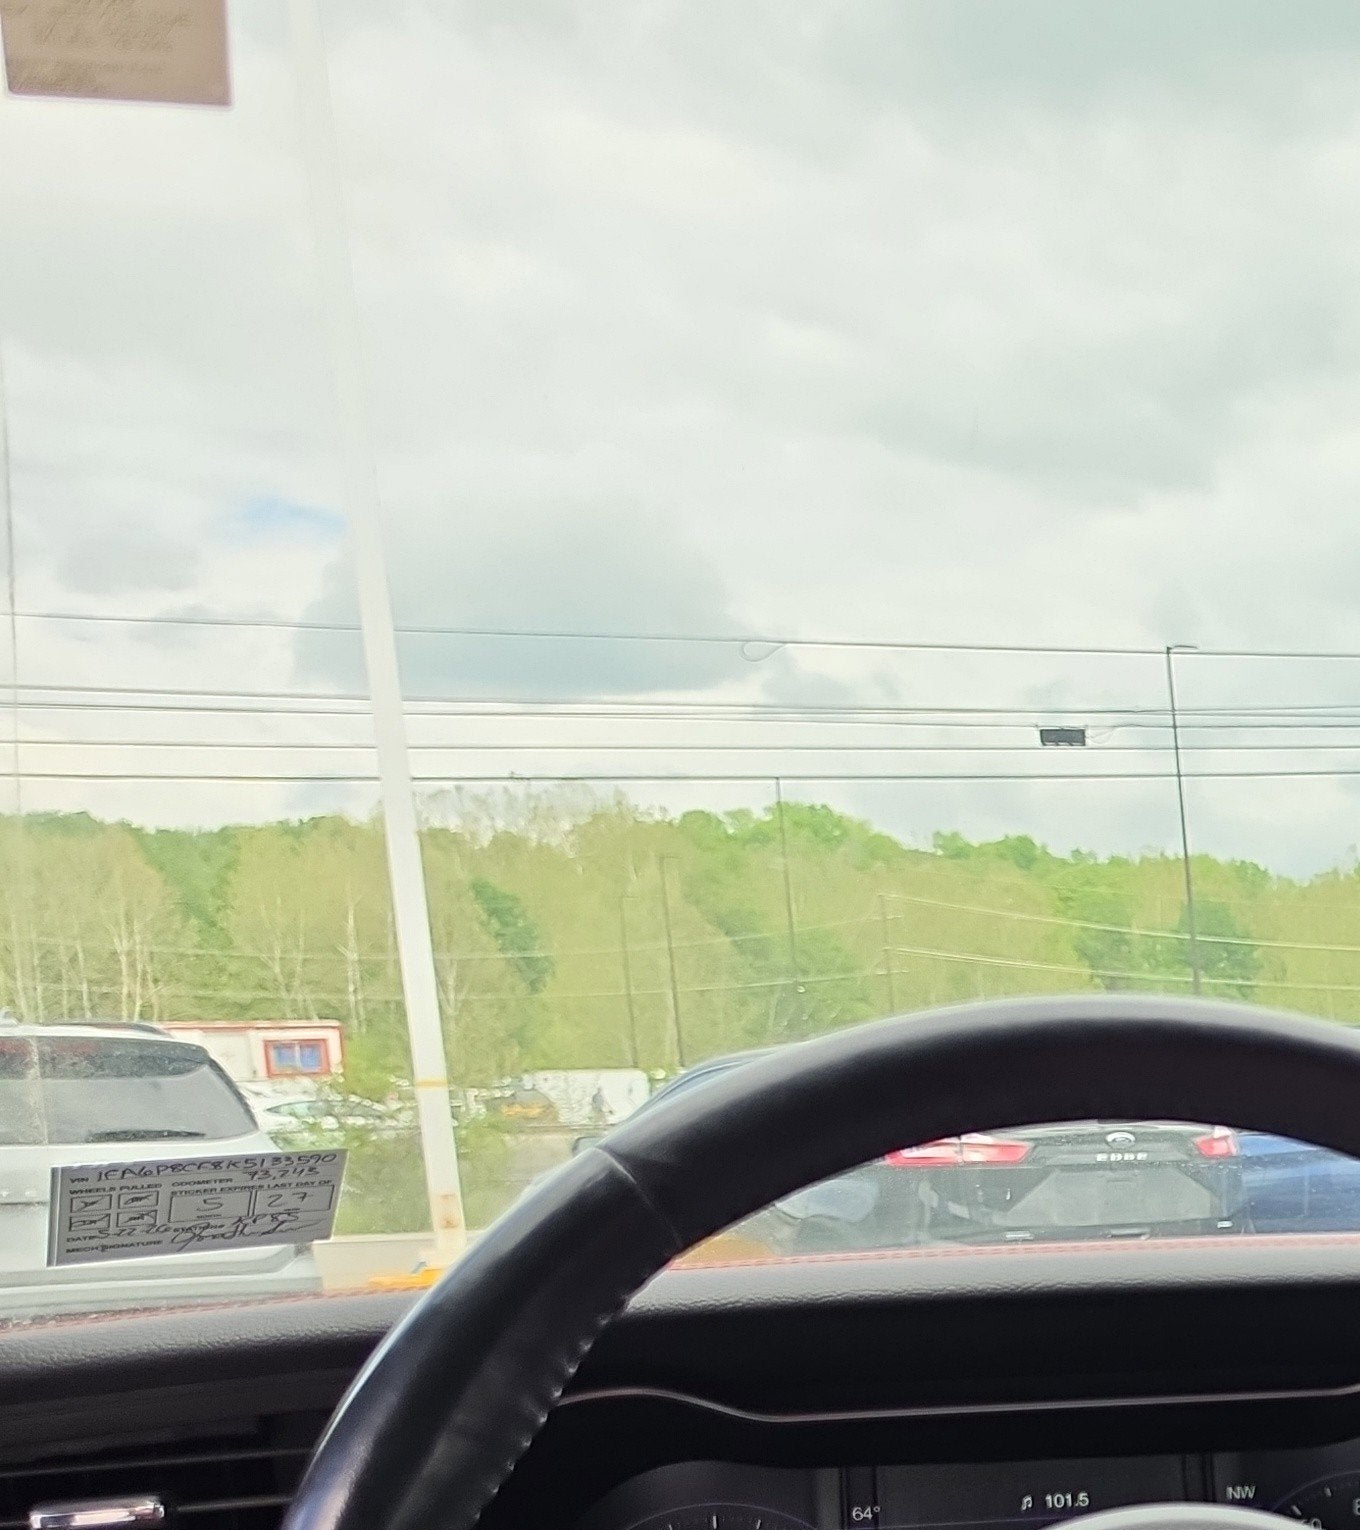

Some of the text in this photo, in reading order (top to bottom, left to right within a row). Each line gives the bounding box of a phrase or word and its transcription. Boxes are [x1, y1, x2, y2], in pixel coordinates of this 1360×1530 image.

[171, 1178, 234, 1187] ODOMETER
[1045, 1492, 1090, 1508] 101.5
[1226, 1485, 1256, 1501] NW
